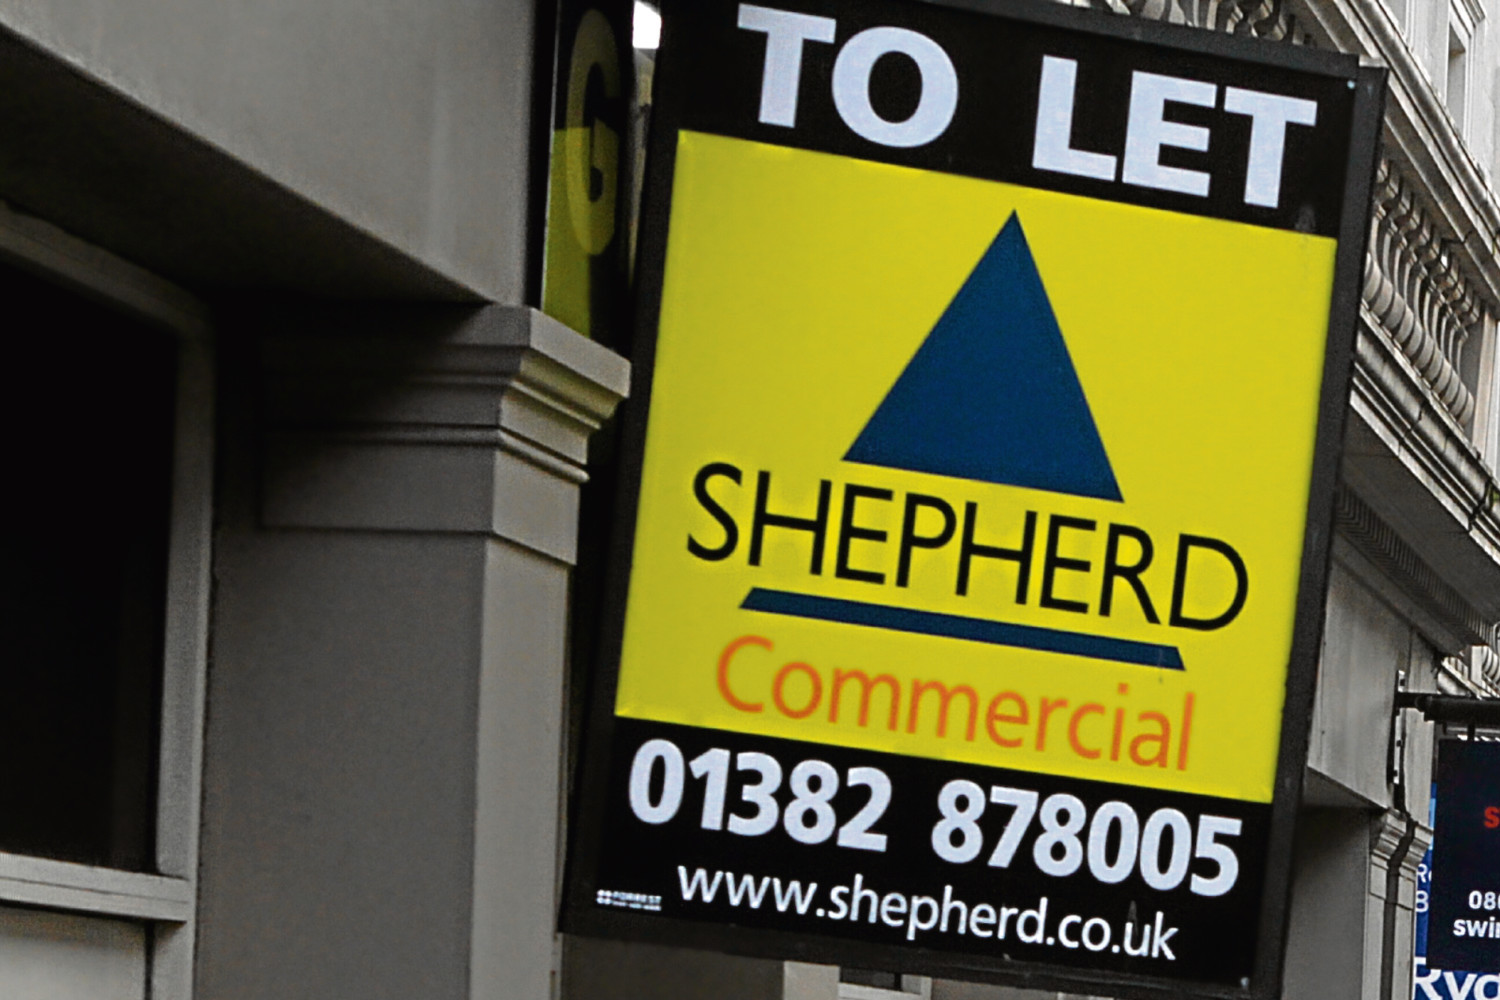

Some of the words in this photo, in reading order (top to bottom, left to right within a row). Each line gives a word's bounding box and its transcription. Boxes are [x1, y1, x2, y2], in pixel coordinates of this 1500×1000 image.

[737, 3, 959, 148] TO
[1031, 55, 1318, 209] LET
[686, 462, 1249, 631] SHEPHERD
[716, 635, 1196, 771] Commercial
[628, 738, 892, 852] 01382
[931, 778, 1243, 897] 878005
[676, 864, 1179, 962] www.shepherd.co.uk
